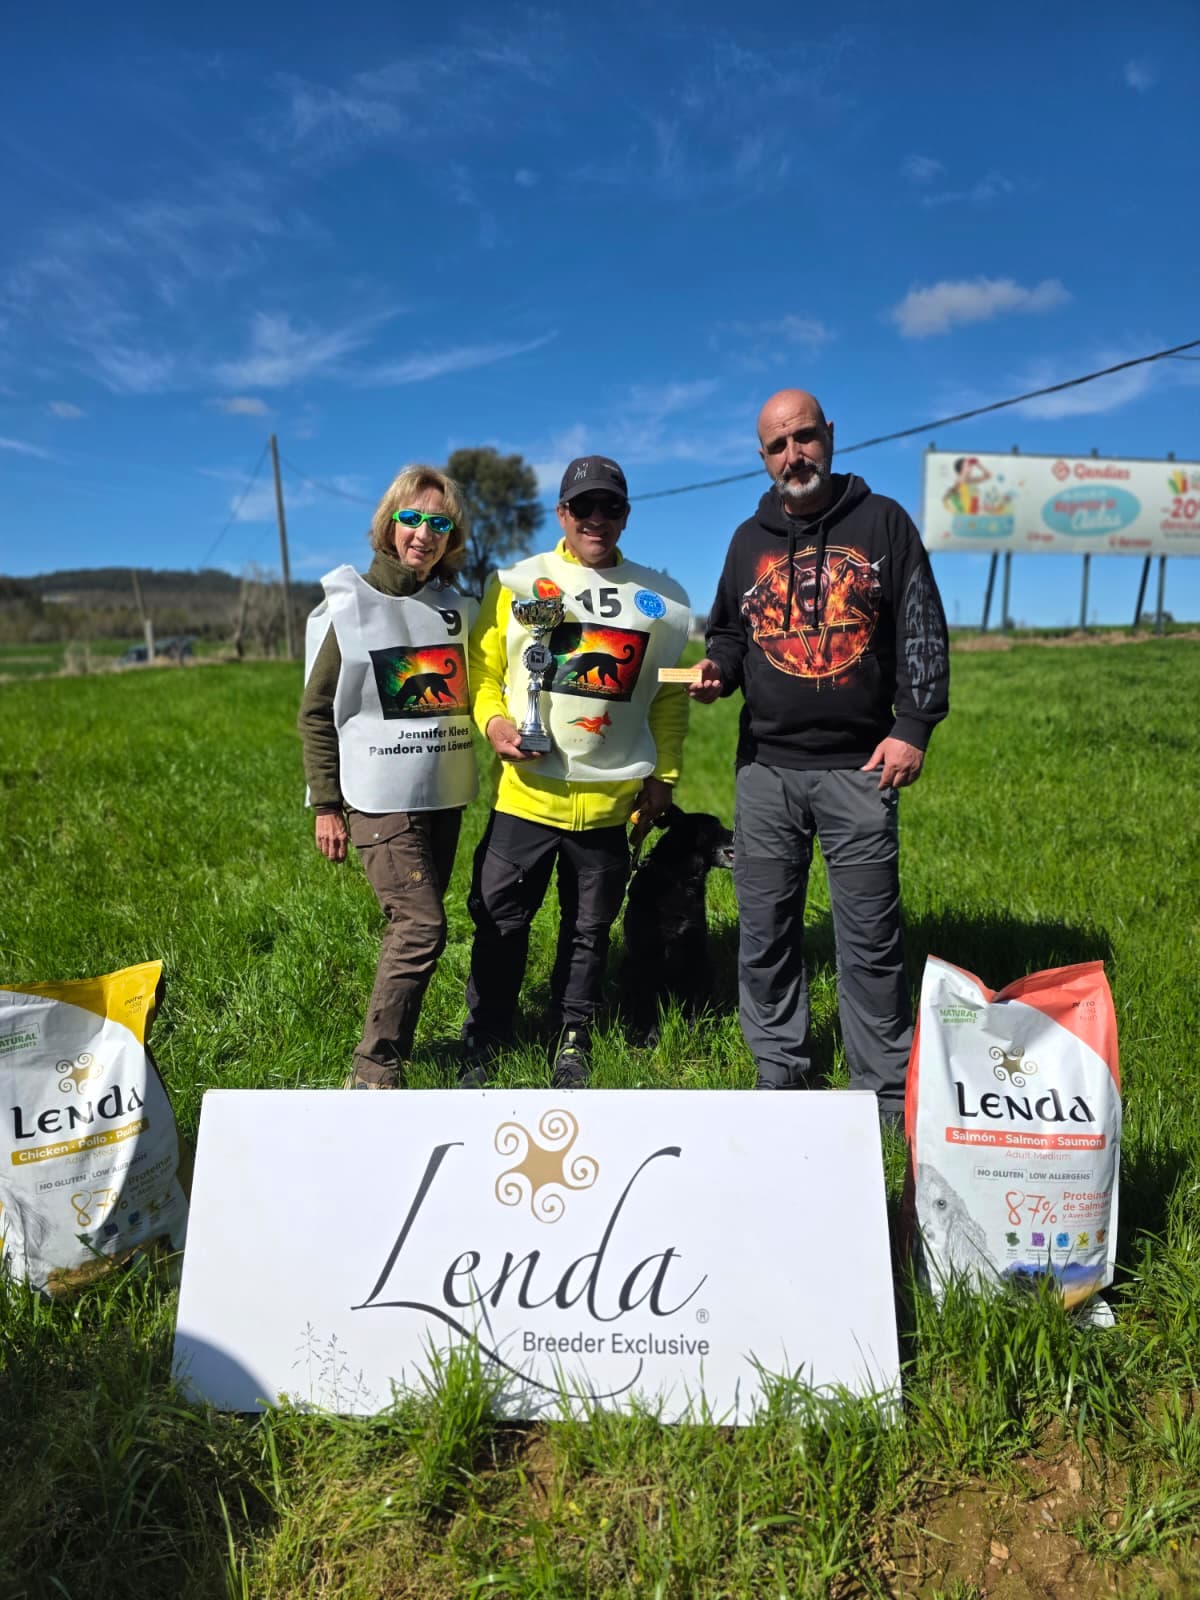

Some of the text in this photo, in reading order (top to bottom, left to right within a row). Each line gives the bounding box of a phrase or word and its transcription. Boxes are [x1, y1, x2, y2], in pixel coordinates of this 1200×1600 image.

[575, 588, 622, 618] 15
[440, 610, 462, 635] 9
[398, 726, 469, 739] Jennifer Klees
[369, 744, 423, 756] Pandora
[427, 745, 446, 753] von
[940, 1009, 977, 1018] NATURAL
[0, 1032, 37, 1048] ATURAL
[952, 1131, 1102, 1147] Salmón Salmon Saumon
[18, 1146, 69, 1162] Chicken
[78, 1137, 107, 1151] Pollo
[1005, 1150, 1072, 1161] Adult Medium
[92, 1168, 110, 1178] LOW
[977, 1168, 1025, 1179] NO GLUTEN
[1029, 1172, 1091, 1181] LOW ALLERGENS
[54, 1174, 86, 1187] GLUTEN
[70, 1187, 129, 1227] 87%
[1005, 1191, 1059, 1228] 87%
[1063, 1202, 1076, 1212] de
[351, 1142, 708, 1399] Lenda
[523, 1331, 711, 1356] Breeder Exclusive
